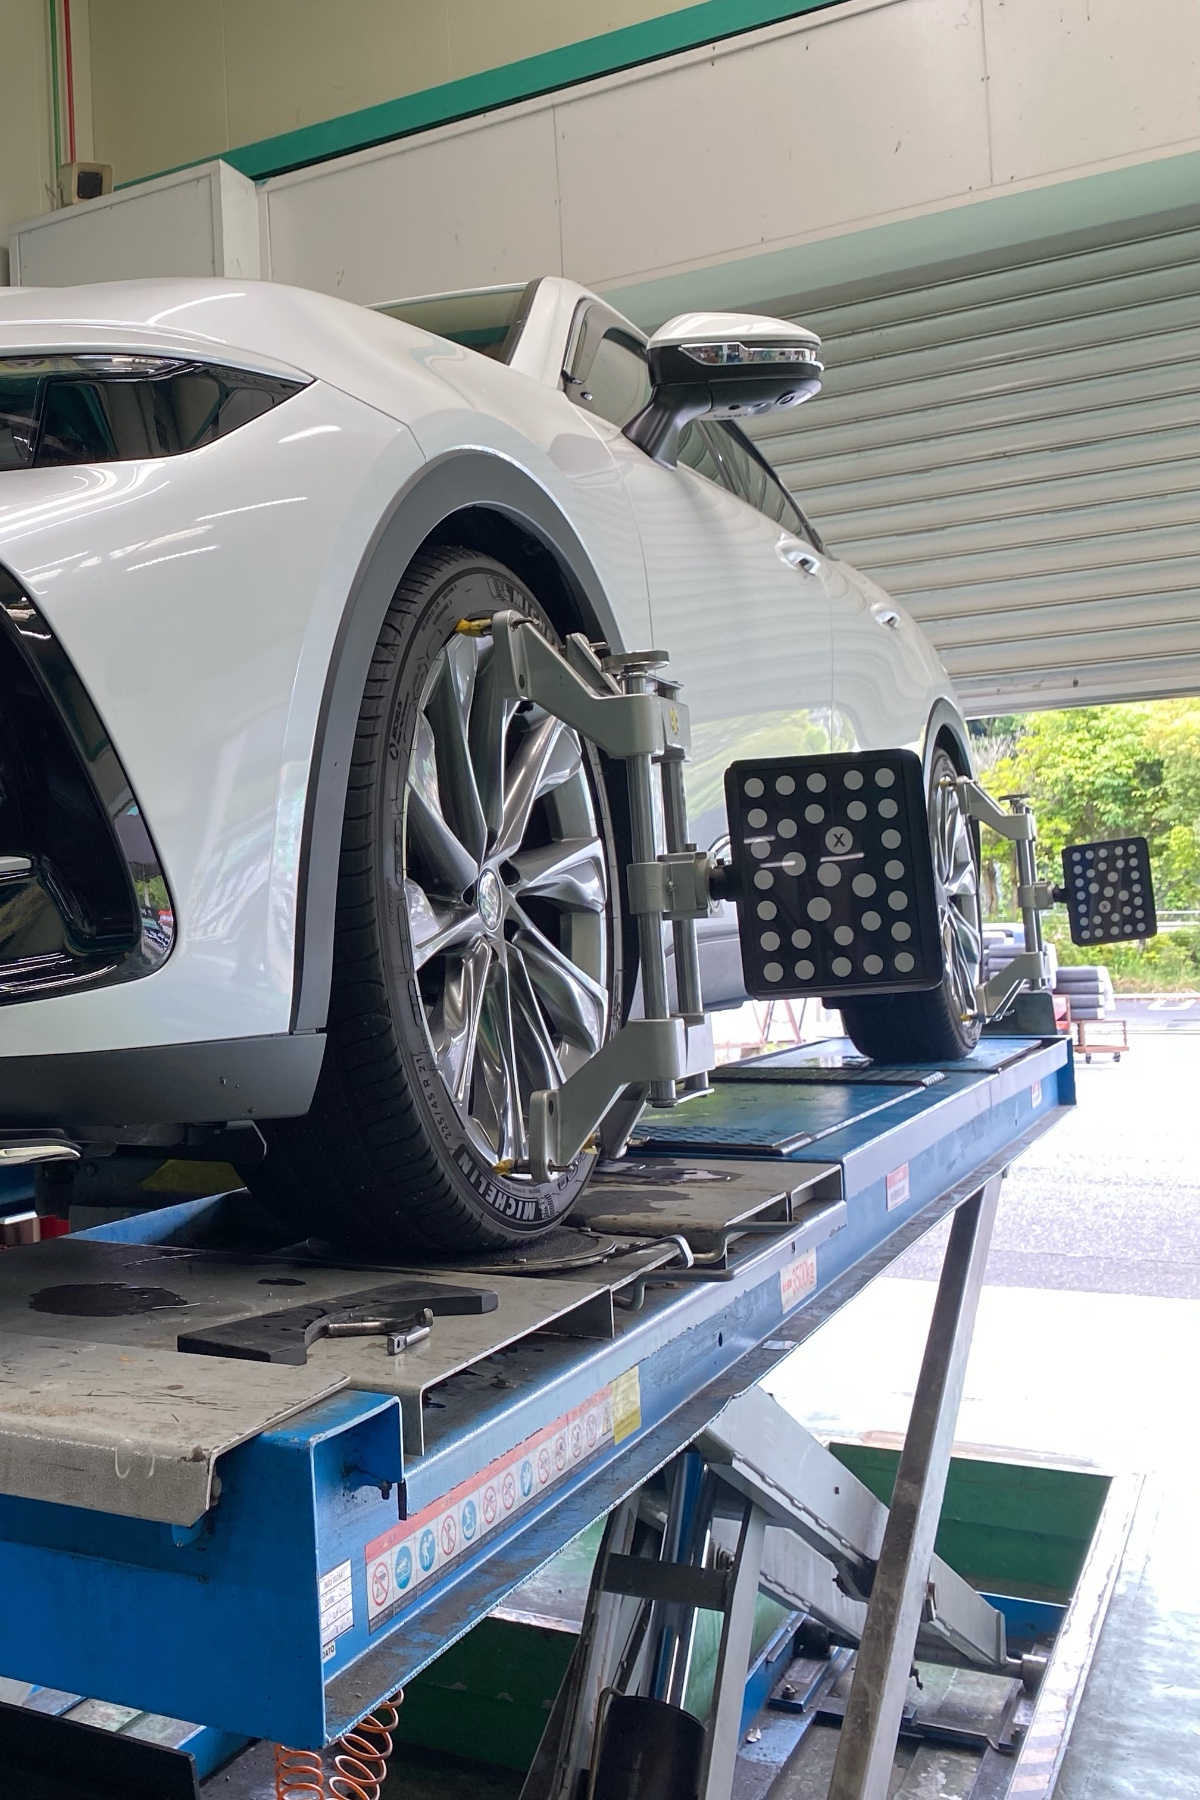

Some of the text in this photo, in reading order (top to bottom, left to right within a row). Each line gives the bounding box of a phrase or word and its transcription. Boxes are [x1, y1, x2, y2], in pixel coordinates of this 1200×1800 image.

[833, 833, 846, 847] X
[416, 1058, 426, 1072] 21
[423, 1079, 431, 1088] R
[458, 1151, 536, 1220] MICHELIN
